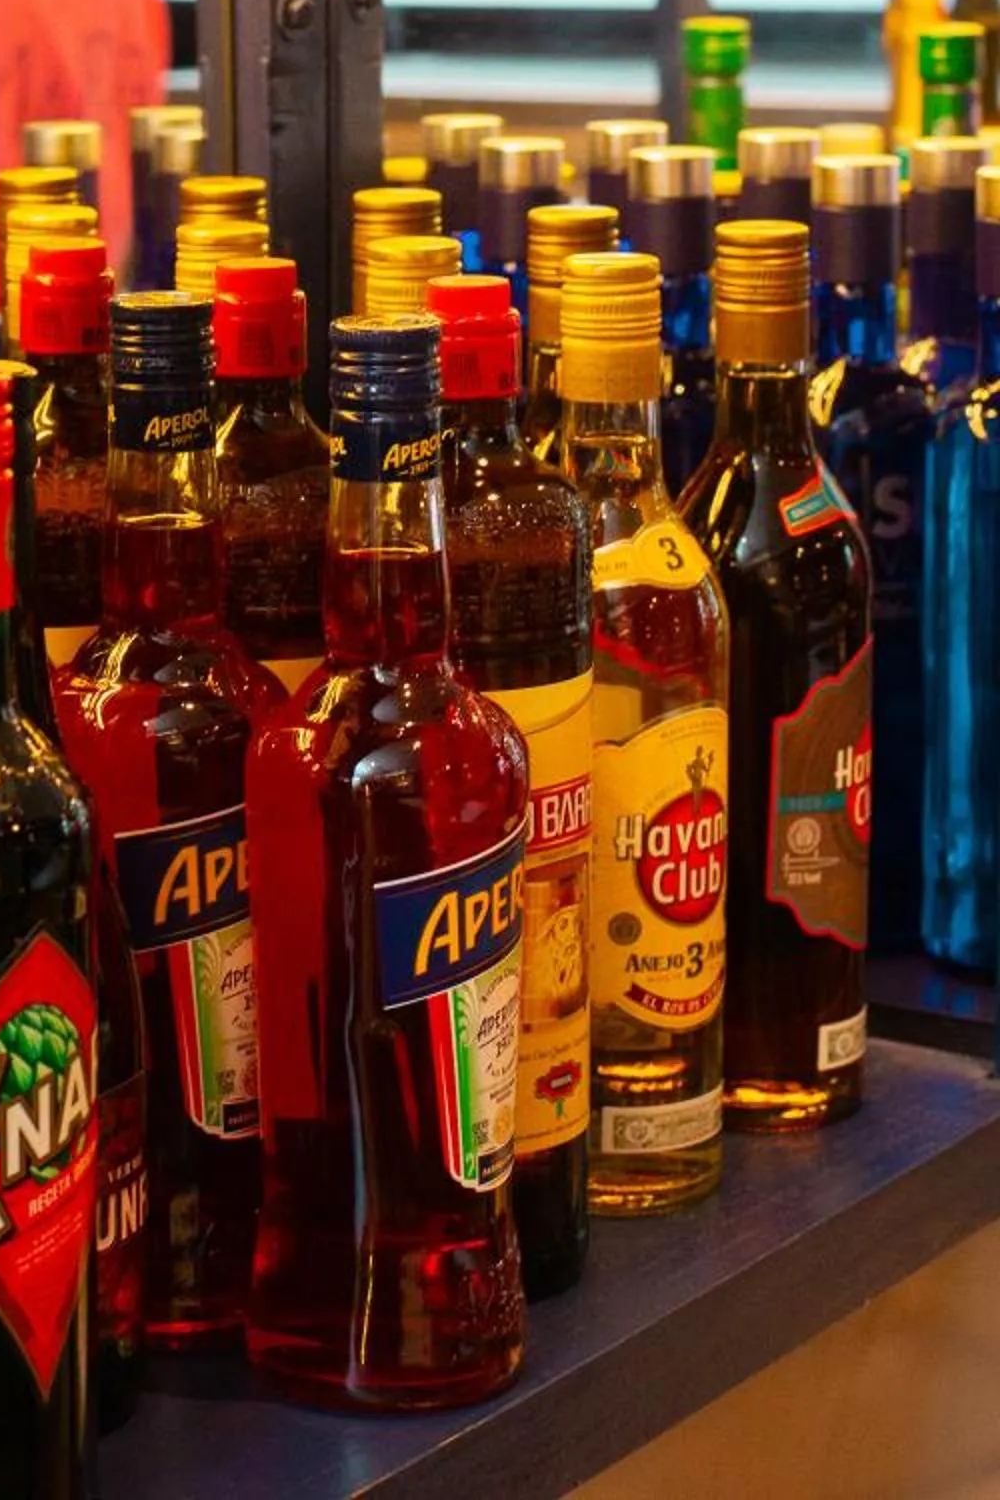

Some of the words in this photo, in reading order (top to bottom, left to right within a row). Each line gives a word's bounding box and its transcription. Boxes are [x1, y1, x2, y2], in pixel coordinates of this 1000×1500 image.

[143, 405, 212, 442] APEROL
[658, 536, 684, 572] 3
[614, 811, 727, 861] Havan
[652, 851, 722, 904] Club
[685, 940, 705, 979] 3
